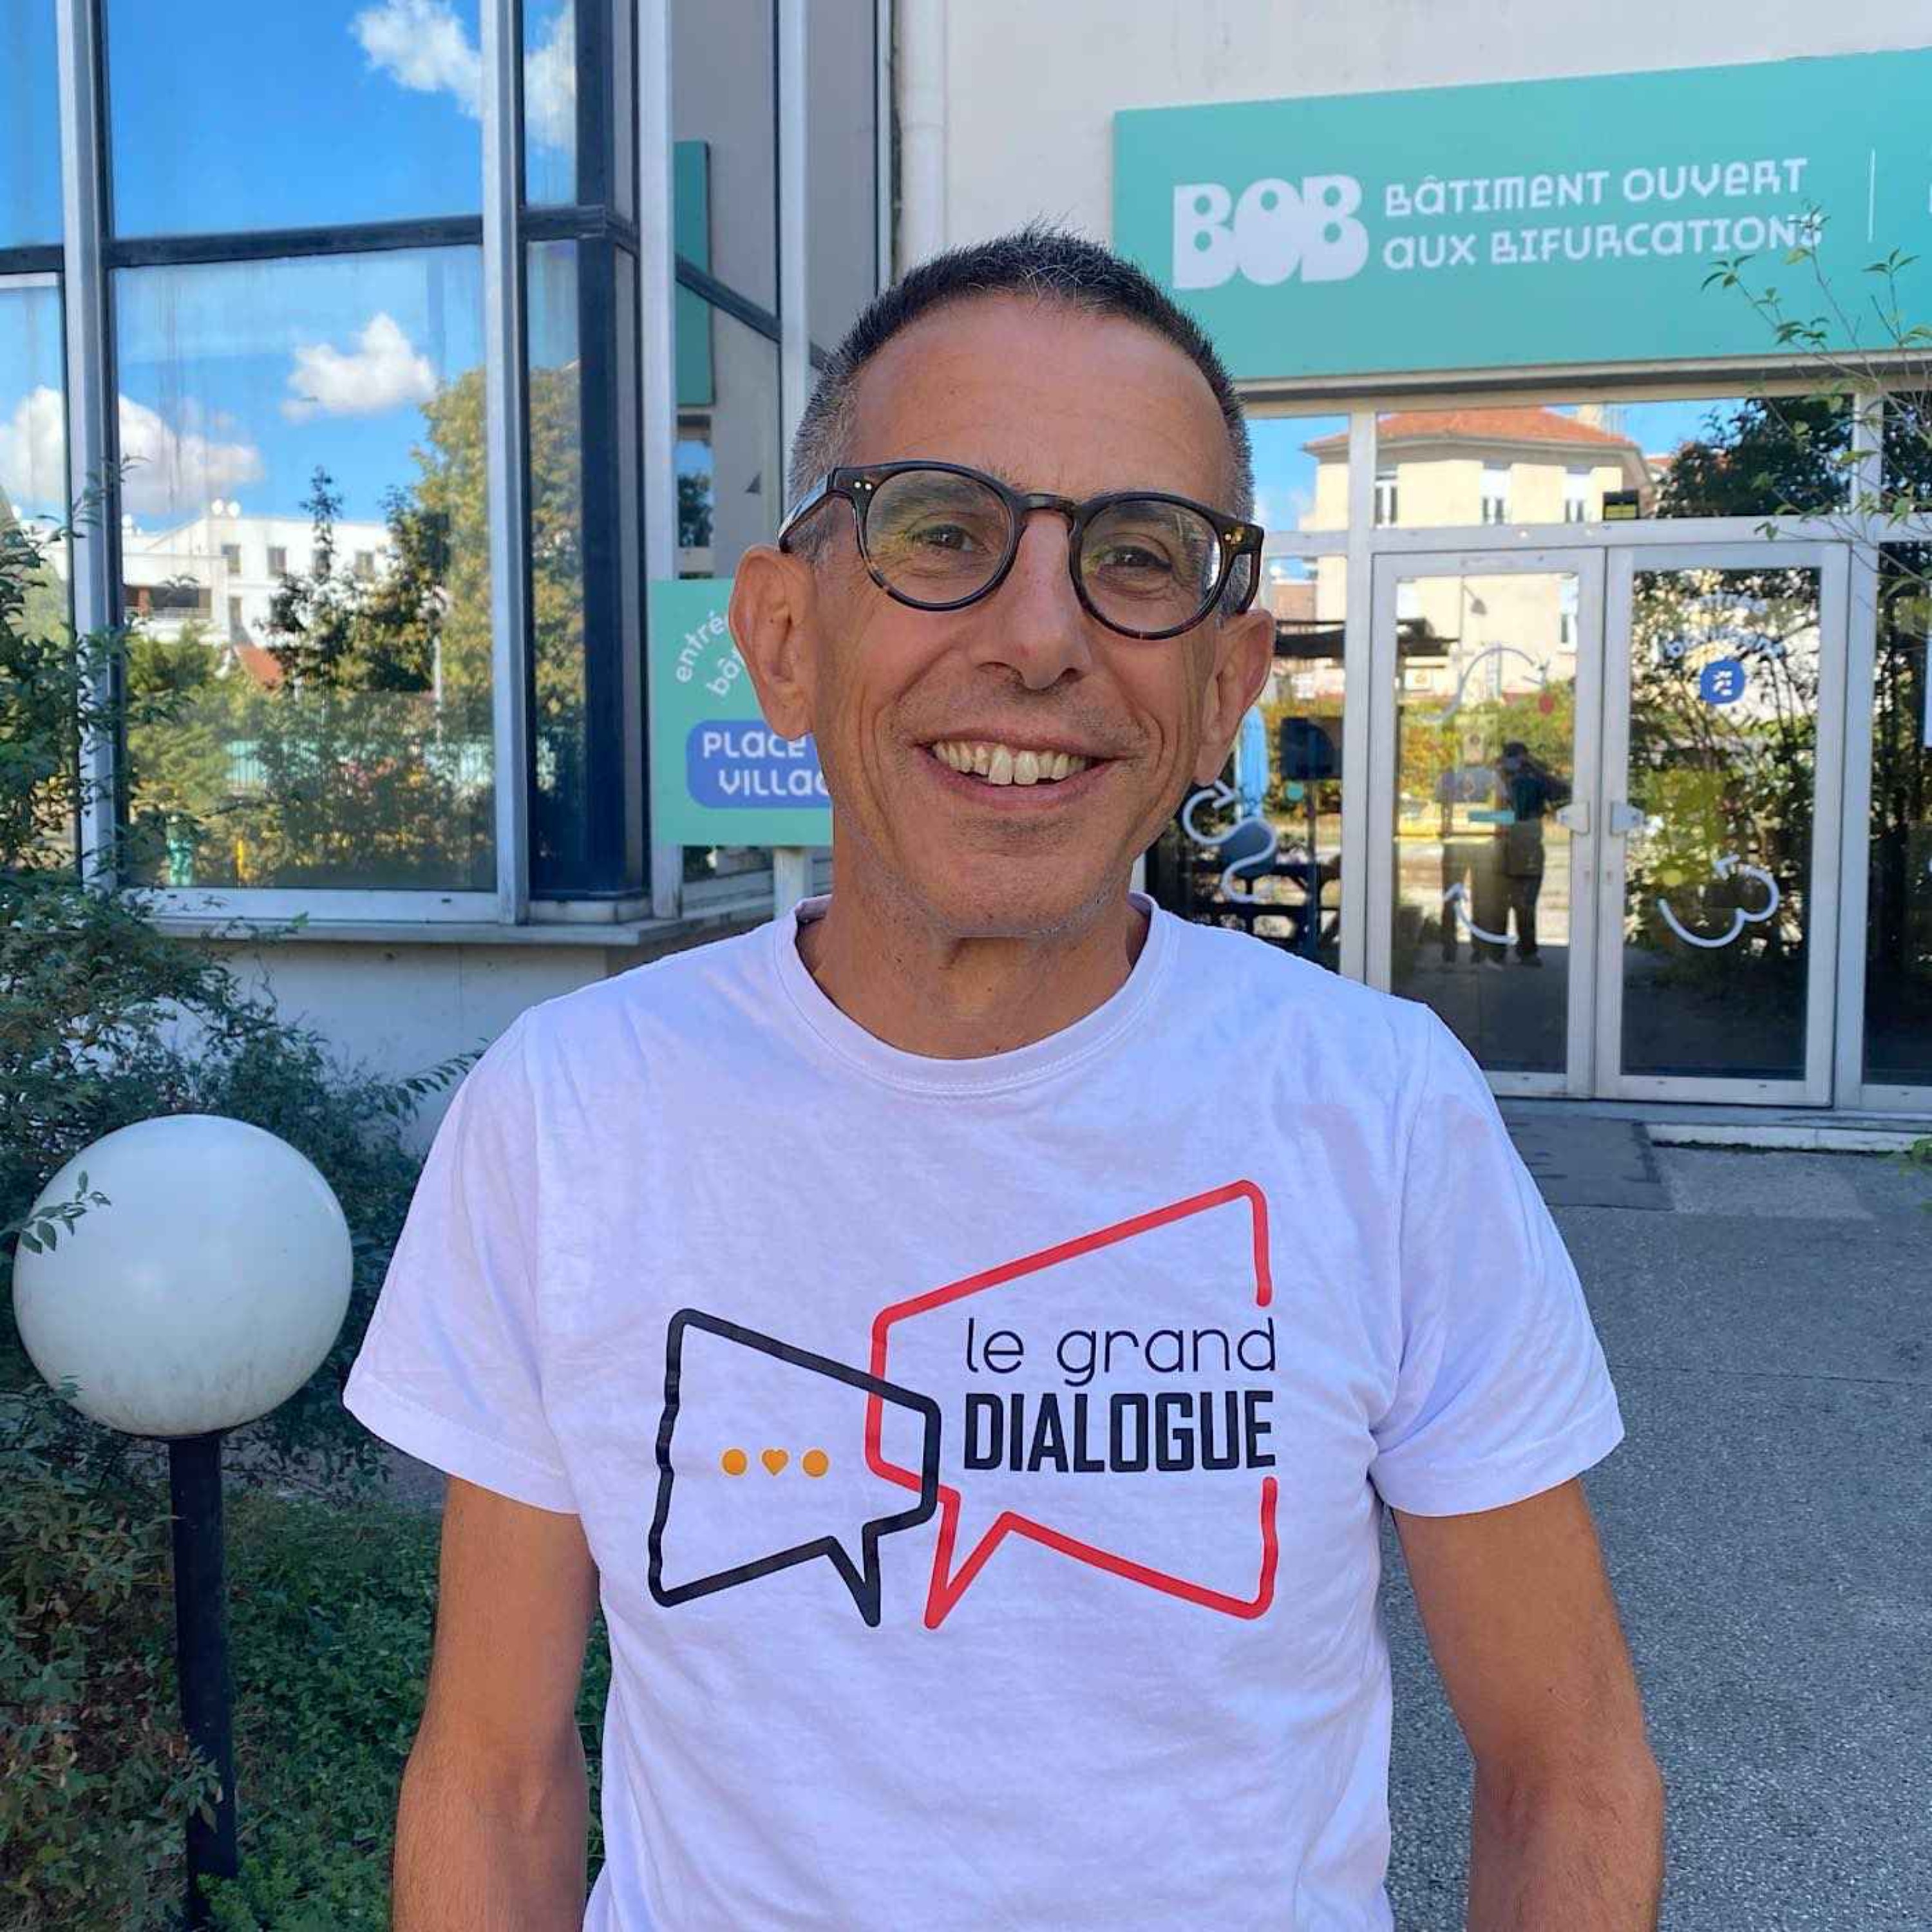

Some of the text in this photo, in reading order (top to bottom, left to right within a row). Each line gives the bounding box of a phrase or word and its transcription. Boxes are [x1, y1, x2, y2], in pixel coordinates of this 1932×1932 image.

[1172, 175, 1368, 289] BOB
[676, 609, 728, 683] entré
[966, 1316, 1276, 1387] le grand
[963, 1390, 1276, 1473] DIALOGUE
